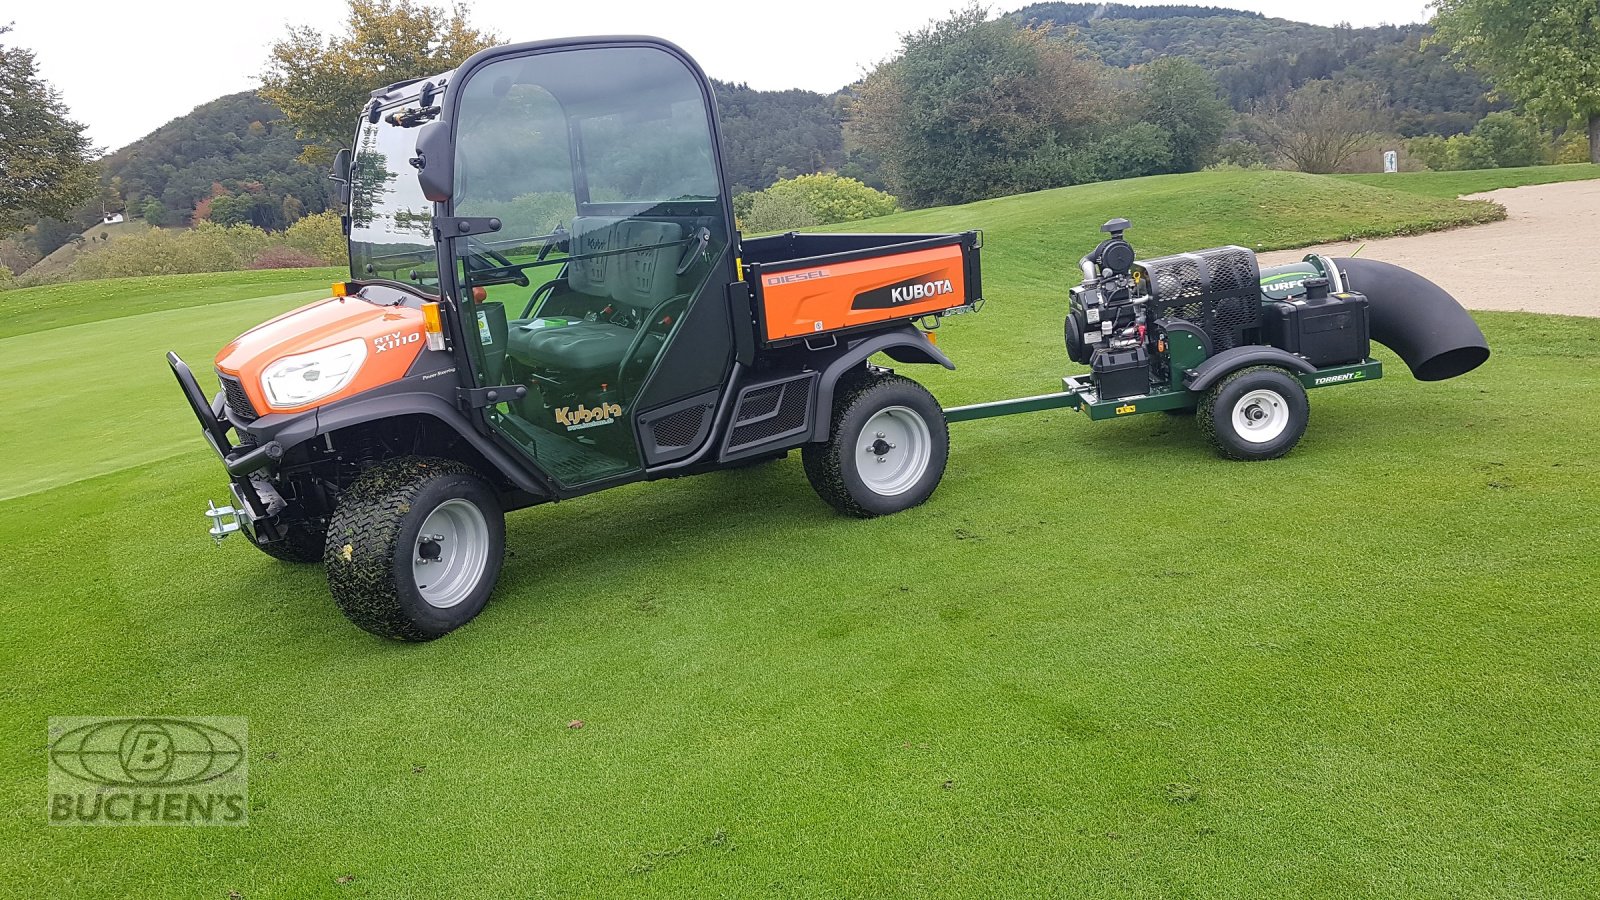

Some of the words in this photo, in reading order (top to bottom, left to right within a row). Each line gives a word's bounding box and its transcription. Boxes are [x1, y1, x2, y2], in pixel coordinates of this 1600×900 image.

[767, 270, 830, 286] DIESEL
[1260, 279, 1306, 293] TURFC
[891, 279, 954, 303] KUBOTA
[374, 331, 400, 345] RTV
[375, 332, 420, 354] X1110
[1314, 372, 1354, 385] TORRENT
[1354, 371, 1366, 379] 2
[554, 402, 623, 426] Kubota
